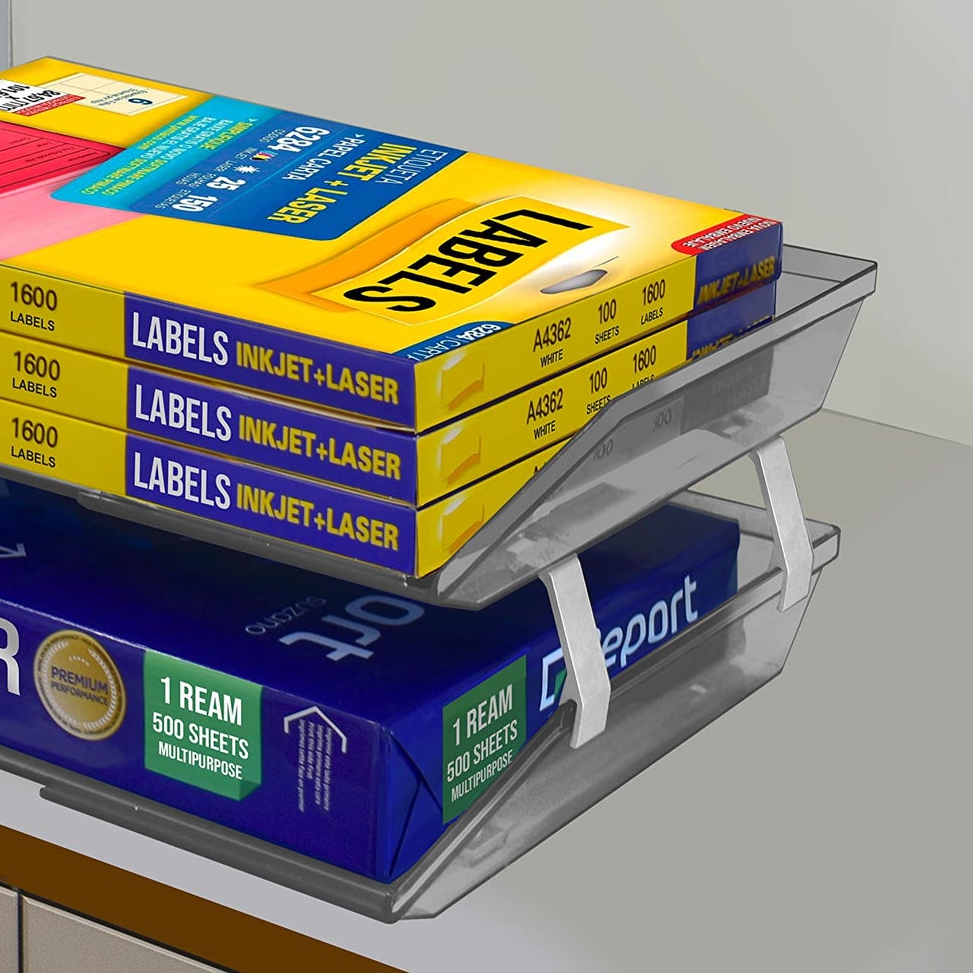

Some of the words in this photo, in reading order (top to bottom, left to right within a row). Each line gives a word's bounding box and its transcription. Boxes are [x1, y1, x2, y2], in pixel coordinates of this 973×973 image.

[269, 127, 329, 152] 6284
[318, 138, 363, 157] PAPEL
[283, 158, 331, 180] CARTA
[339, 144, 414, 180] INKJET
[377, 149, 446, 184] ETIQUETA
[207, 177, 246, 190] 25
[172, 195, 217, 211] 150
[269, 188, 345, 223] LASER
[343, 208, 592, 312] LABELS
[10, 281, 57, 311] 1600
[697, 255, 776, 305] INKJET+LASER
[10, 311, 55, 331] LABELS
[533, 317, 571, 352] A4362
[598, 299, 617, 324] 100
[642, 279, 665, 305] 1600
[541, 349, 563, 367] WHITE
[595, 326, 619, 345] SHEETS
[641, 307, 663, 325] LABELS
[13, 351, 60, 381] 1600
[133, 311, 229, 366] LABELS
[237, 341, 399, 405] INKJET+LASER
[12, 378, 57, 398] LABELS
[527, 388, 563, 425] A4362
[589, 368, 607, 394] 100
[633, 345, 657, 373] 1600
[11, 417, 58, 448] 1600
[135, 384, 231, 442] LABELS
[239, 415, 401, 479] INKJET+LASER
[533, 421, 555, 439] WHITE
[11, 446, 56, 468] LABELS
[134, 452, 231, 509] LABELS
[237, 483, 399, 551] INKJET+LASER
[597, 575, 699, 667] eport
[51, 666, 107, 695] PREMIUM
[51, 681, 107, 705] PERFORMANCE
[160, 676, 170, 704] 1
[179, 681, 241, 726] REAM
[452, 717, 461, 747] 1
[466, 684, 513, 739] REAM
[153, 711, 183, 739] 500
[189, 723, 249, 759] SHEETS
[447, 752, 471, 783] 500
[473, 720, 519, 765] SHEETS
[159, 741, 243, 779] MULTIPURPOSE
[451, 749, 513, 803] MULTIPURPOSE
